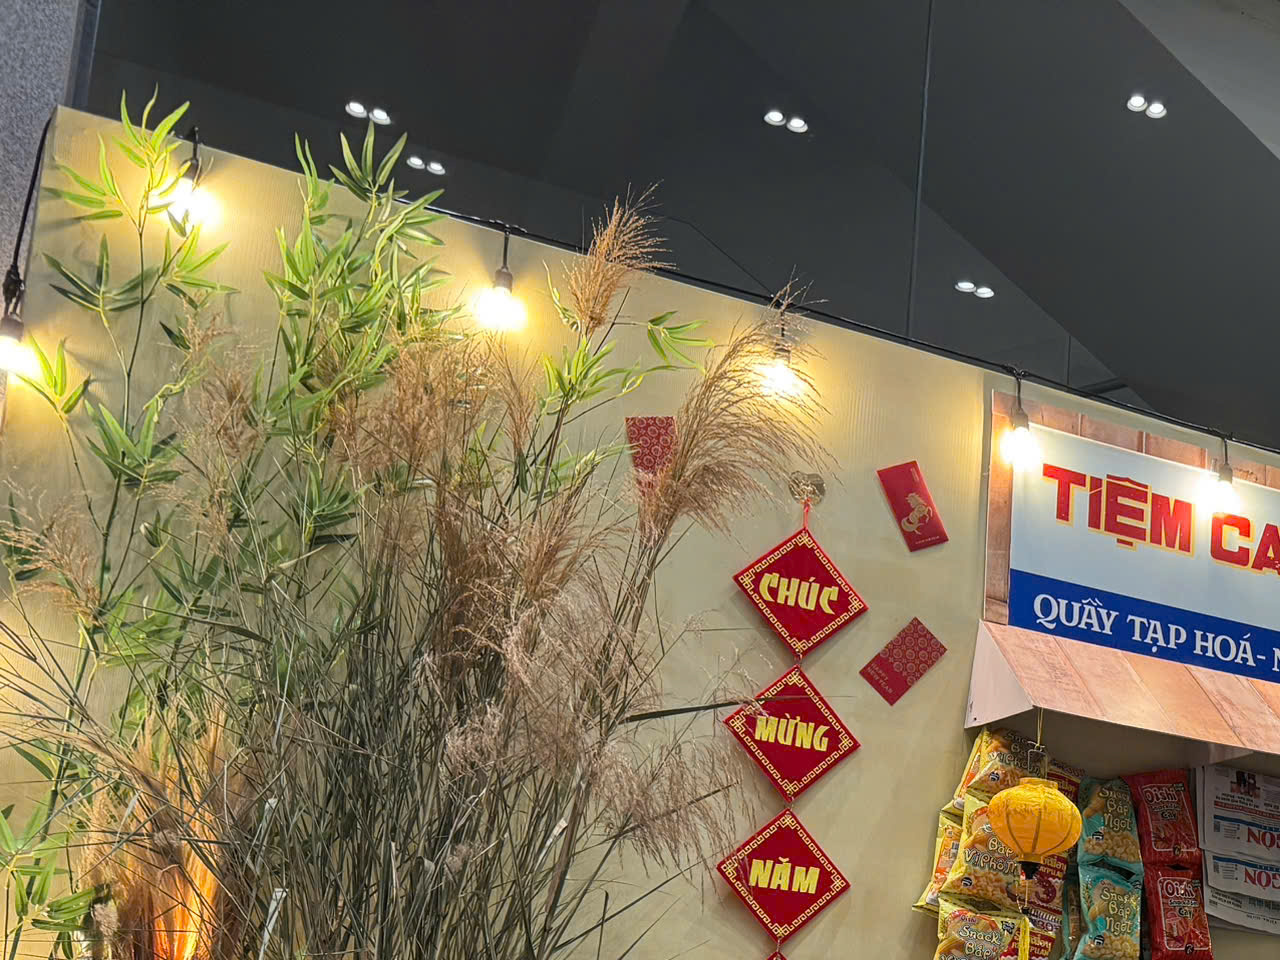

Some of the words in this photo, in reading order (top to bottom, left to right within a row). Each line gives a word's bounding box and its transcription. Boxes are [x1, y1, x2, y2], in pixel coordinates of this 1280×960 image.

[1042, 463, 1194, 556] TIỆM
[758, 571, 839, 614] CHÚC
[1033, 593, 1119, 636] QUẦY
[1126, 614, 1187, 653] TẠP
[755, 714, 829, 752] MỪNG
[1143, 787, 1178, 804] Oishi
[748, 856, 820, 895] NĂM
[1163, 879, 1195, 898] Oishi
[960, 925, 1001, 946] Snack
